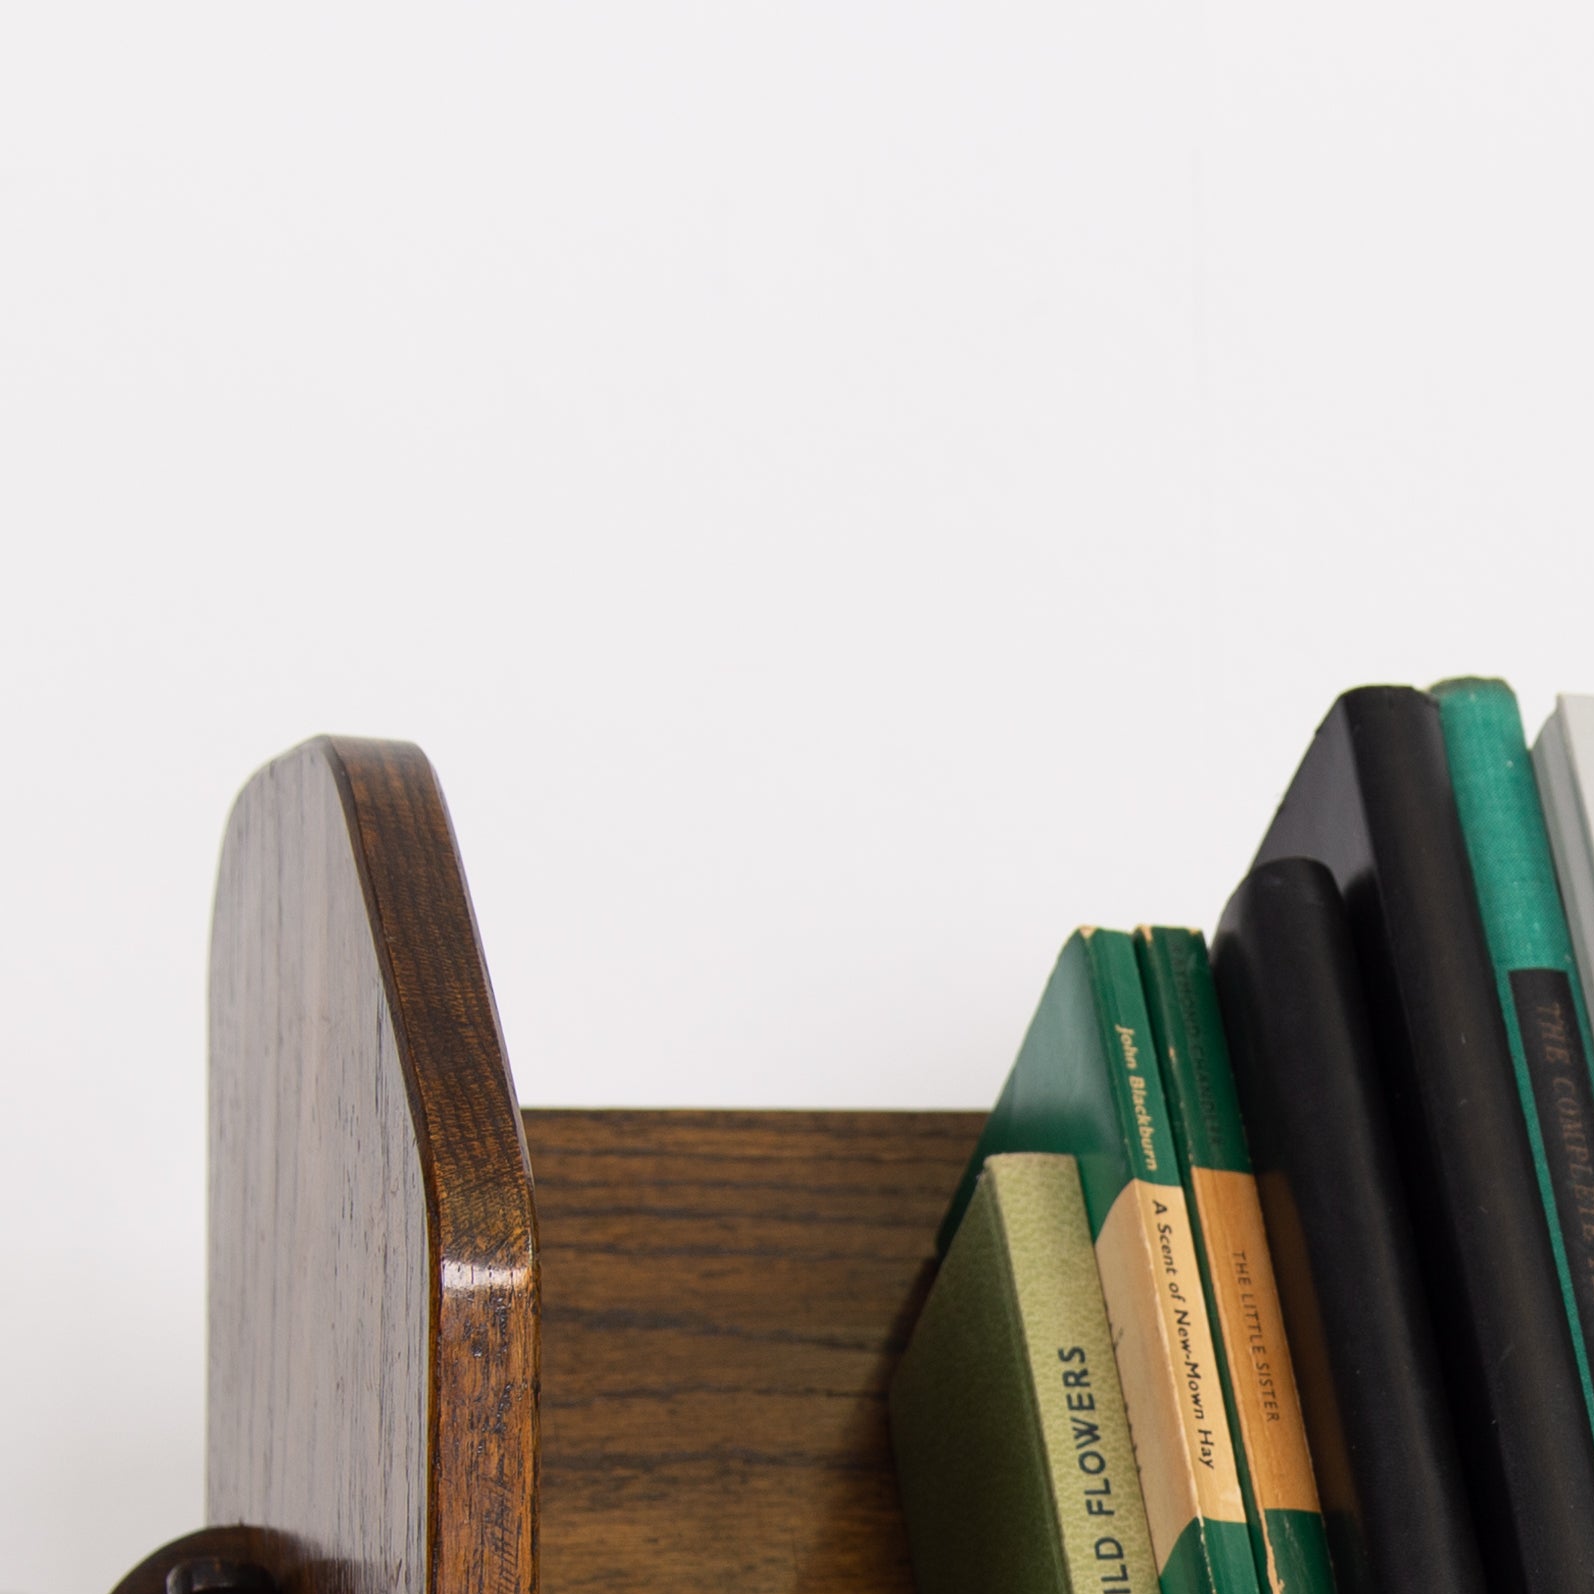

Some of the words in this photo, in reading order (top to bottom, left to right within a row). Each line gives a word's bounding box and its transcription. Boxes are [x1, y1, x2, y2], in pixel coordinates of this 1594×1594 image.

[1537, 1002, 1573, 1067] THE
[1115, 1024, 1137, 1069] John
[1129, 1075, 1157, 1172] Blackburn
[1152, 1199, 1168, 1216] A
[1157, 1222, 1179, 1276] Scent
[1232, 1251, 1253, 1286] THE
[1168, 1280, 1186, 1304] of
[1240, 1293, 1267, 1355] LITTLE
[1174, 1307, 1206, 1420] New-Mown
[1255, 1362, 1280, 1423] SISTER
[1058, 1346, 1116, 1516] FLOWERS
[1197, 1429, 1215, 1471] Hay
